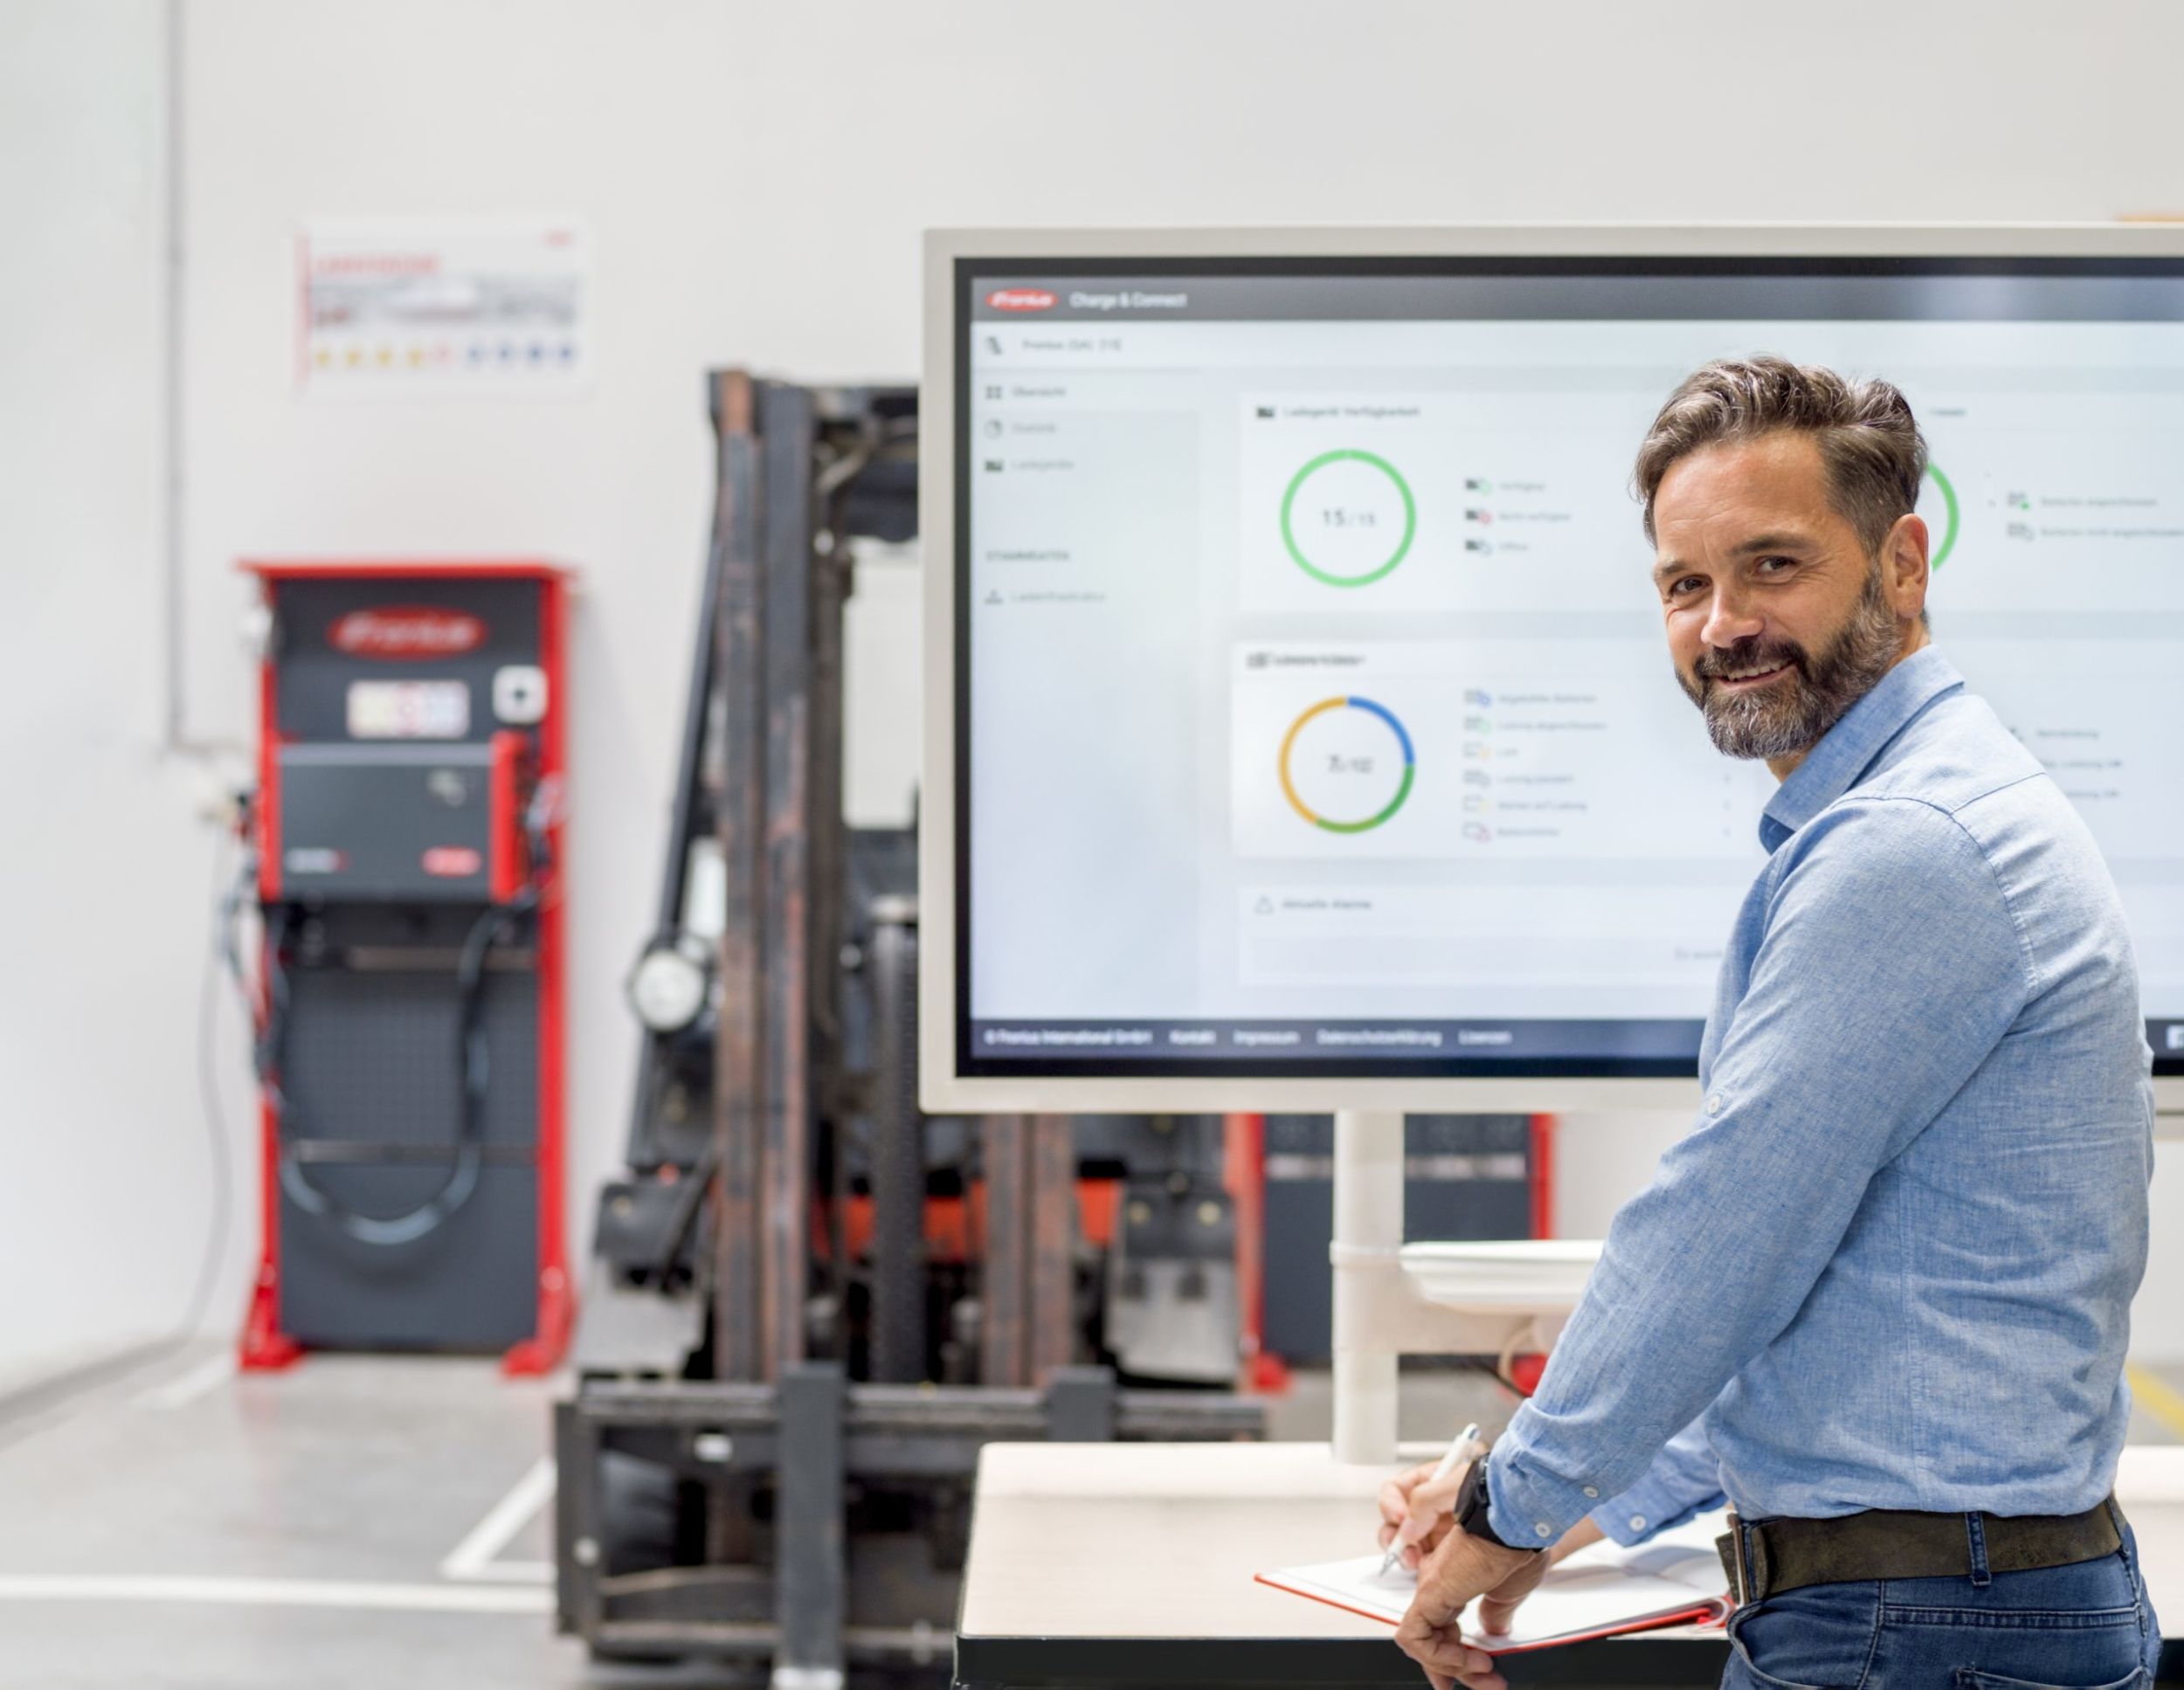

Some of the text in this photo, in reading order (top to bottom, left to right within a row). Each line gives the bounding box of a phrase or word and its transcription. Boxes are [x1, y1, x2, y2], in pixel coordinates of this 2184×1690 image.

[1068, 291, 1187, 311] Charge & Connect
[1322, 507, 1345, 528] 15
